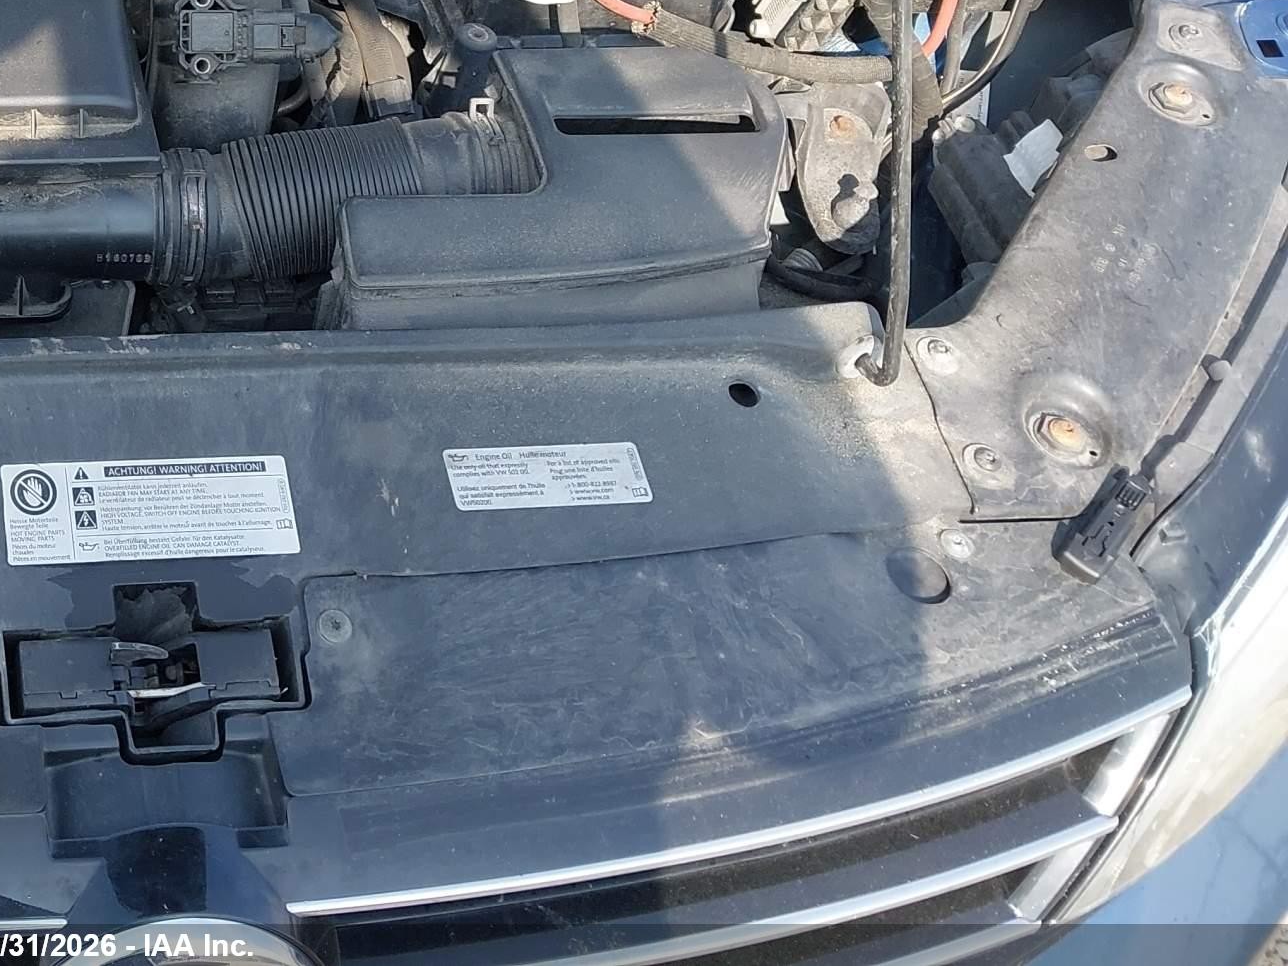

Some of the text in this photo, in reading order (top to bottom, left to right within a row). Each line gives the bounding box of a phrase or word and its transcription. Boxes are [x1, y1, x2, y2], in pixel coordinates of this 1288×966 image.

[475, 453, 500, 462] Engine
[501, 452, 513, 460] Oil
[108, 462, 263, 476] ACHTUNG! WARNING! ATTENTION!
